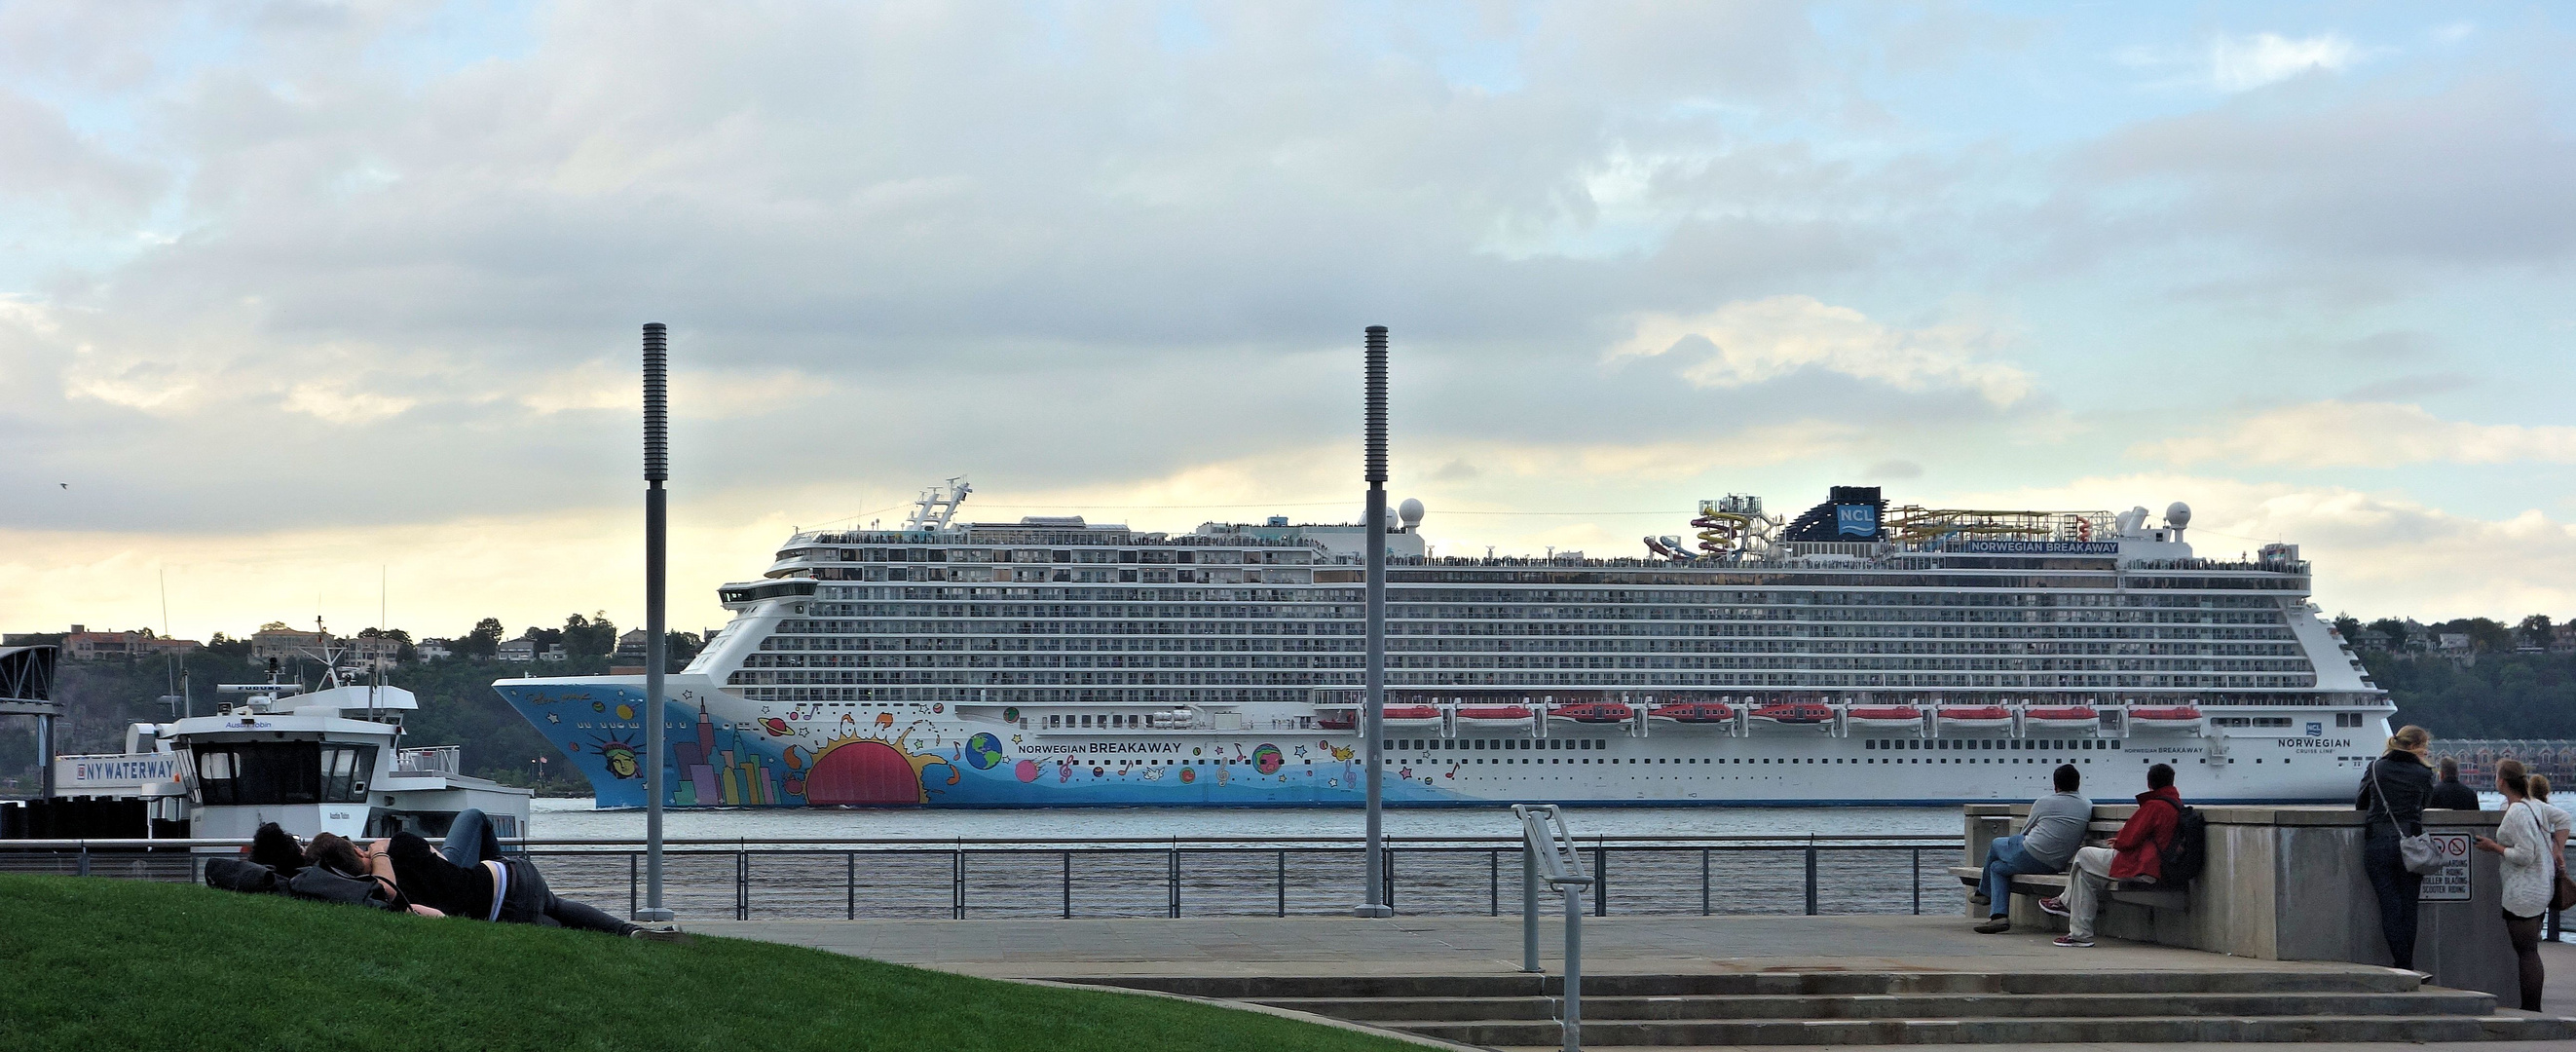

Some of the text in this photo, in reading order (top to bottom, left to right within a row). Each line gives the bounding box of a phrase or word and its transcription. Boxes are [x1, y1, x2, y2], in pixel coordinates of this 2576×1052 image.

[1841, 509, 1874, 522] NCL
[1971, 542, 2117, 552] NORWEGIAN BREAKAWAY
[1019, 742, 1181, 754] NORWEGIAN BREAKAWAY
[2278, 738, 2351, 748] NORWEGIAN
[87, 760, 174, 780] NY WATERWAY
